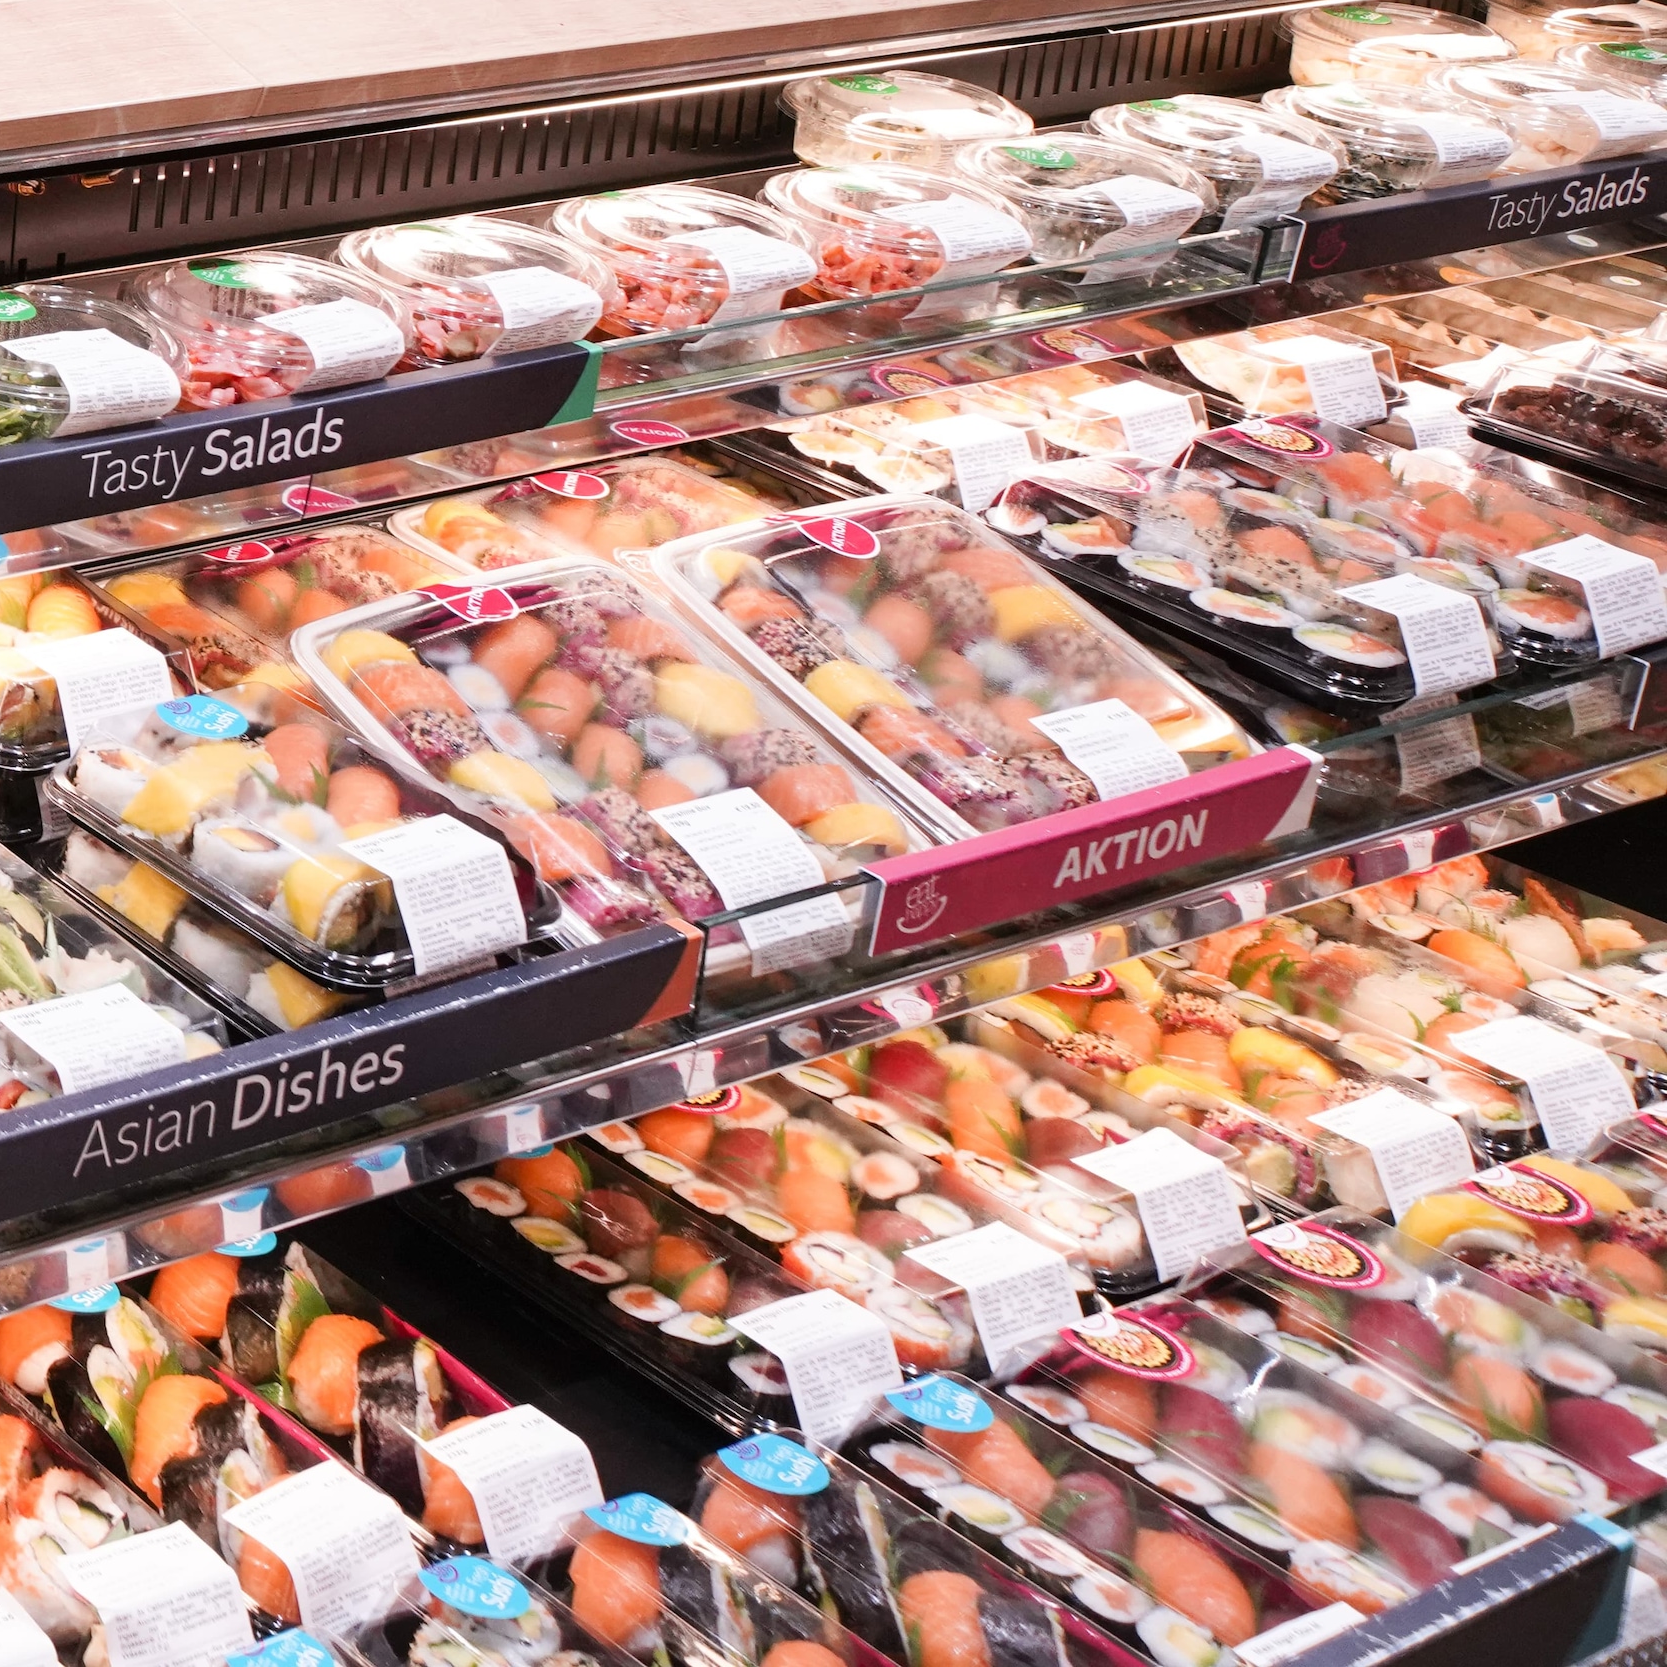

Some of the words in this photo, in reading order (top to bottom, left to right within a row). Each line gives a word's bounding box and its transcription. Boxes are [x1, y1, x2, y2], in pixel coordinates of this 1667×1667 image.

[1487, 190, 1558, 235] Tasty
[1556, 168, 1651, 219] Salads
[81, 445, 196, 499] Tasty
[200, 407, 345, 477] Salads
[204, 707, 242, 734] Sushi
[1053, 808, 1210, 889] AKTION
[906, 875, 942, 909] eat
[73, 1089, 217, 1177] Asian
[229, 1036, 405, 1133] Dishes
[947, 1388, 979, 1425] Sushi
[778, 1451, 818, 1488] Sushi
[481, 1572, 517, 1611] Sushi
